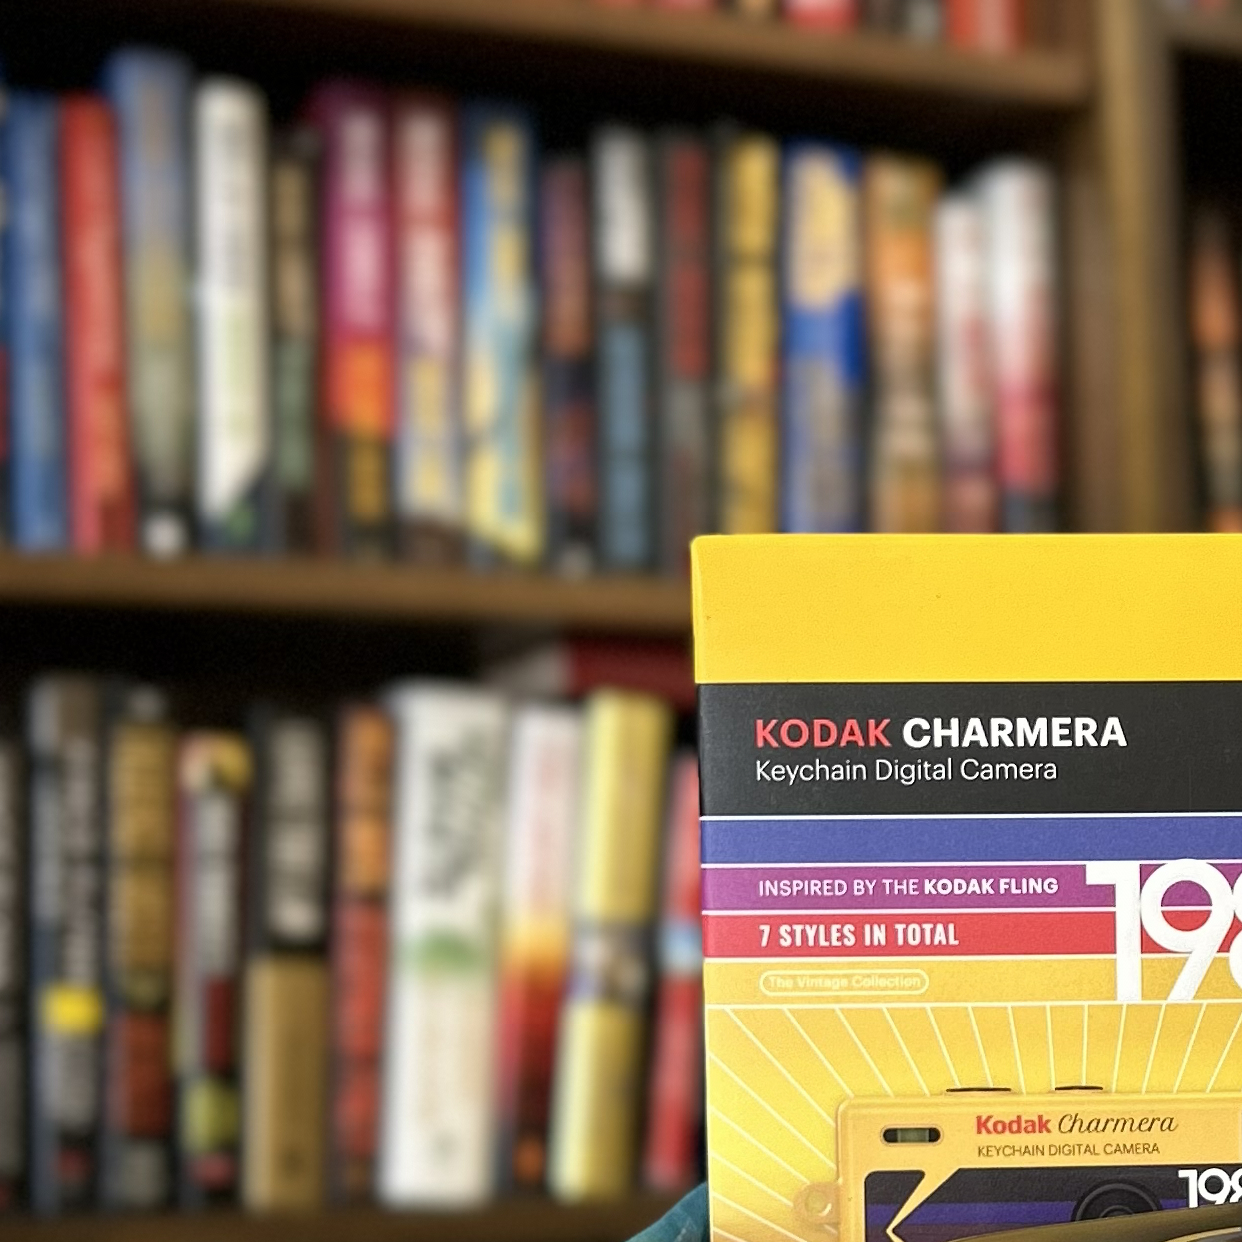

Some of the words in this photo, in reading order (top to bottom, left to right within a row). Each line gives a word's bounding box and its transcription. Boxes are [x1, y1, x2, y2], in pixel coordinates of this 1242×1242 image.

[755, 719, 892, 748] KODAK
[903, 717, 1128, 747] CHARMERA
[756, 760, 867, 785] Keychain
[876, 758, 952, 784] Digital
[961, 758, 1058, 780] Camera
[759, 880, 848, 896] INSPIRED
[853, 879, 877, 895] BY
[883, 879, 919, 895] THE
[924, 878, 995, 895] KODAK
[999, 878, 1059, 894] FLING
[759, 925, 771, 947] 7
[779, 924, 856, 947] STYLES
[864, 924, 886, 946] IN
[895, 923, 959, 945] TOTAL
[769, 976, 794, 988] The
[797, 976, 849, 990] Vintage
[852, 975, 921, 988] Collection
[976, 1114, 1052, 1135] Kodak
[1057, 1113, 1178, 1135] Charmera
[978, 1145, 1045, 1157] KEYCHAIN
[1049, 1144, 1100, 1156] DIGITAL
[1103, 1143, 1160, 1155] CAMERA
